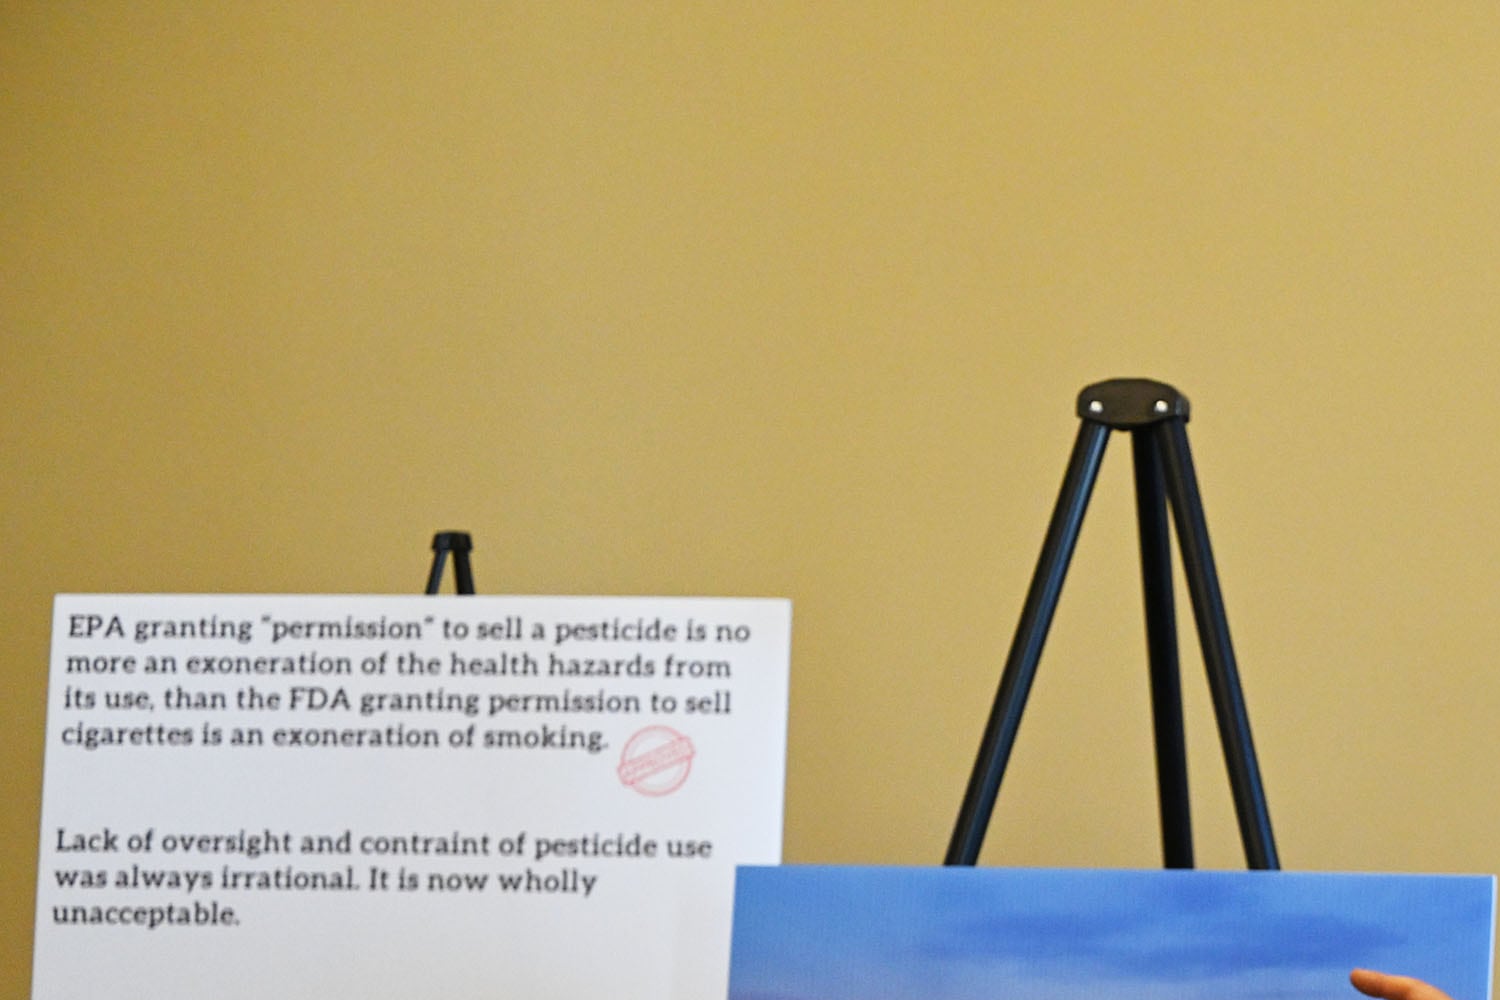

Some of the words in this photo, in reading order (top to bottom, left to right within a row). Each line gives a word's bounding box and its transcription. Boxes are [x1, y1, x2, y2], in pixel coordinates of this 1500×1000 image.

[68, 614, 126, 639] EPA
[134, 615, 253, 644] granting
[442, 619, 470, 640] to
[476, 616, 523, 641] sell
[530, 623, 546, 641] a
[554, 618, 678, 646] pesticide
[686, 619, 707, 642] is
[716, 625, 751, 643] no
[66, 655, 137, 674] more
[143, 655, 177, 674] an
[185, 651, 352, 675] exoneration
[360, 651, 388, 675] of
[396, 651, 442, 676] the
[450, 651, 539, 677] health
[548, 652, 656, 677] hazards
[664, 654, 732, 678] from
[64, 685, 96, 710] its
[104, 691, 155, 714] use,
[163, 685, 227, 710] than
[236, 685, 281, 711] the
[289, 686, 352, 711] FDA
[359, 689, 480, 718] granting
[488, 689, 641, 717] permission
[650, 693, 678, 714] to
[685, 690, 731, 715] sell
[61, 721, 194, 751] cigarettes
[201, 722, 223, 746] is
[230, 728, 264, 746] an
[272, 723, 440, 748] exoneration
[448, 723, 475, 748] of
[483, 724, 608, 754] smoking.
[56, 827, 119, 853] Lack
[126, 828, 154, 853] of
[161, 829, 292, 859] oversight
[300, 829, 352, 855] and
[359, 831, 490, 856] contraint
[498, 832, 526, 857] of
[534, 833, 658, 862] pesticide
[666, 840, 713, 858] use
[54, 870, 108, 889] was
[114, 863, 214, 894] always
[221, 865, 360, 891] irrational.
[369, 866, 389, 891] It
[398, 867, 419, 891] is
[427, 873, 489, 892] now
[498, 867, 597, 897] wholly
[52, 900, 240, 930] unacceptable.
